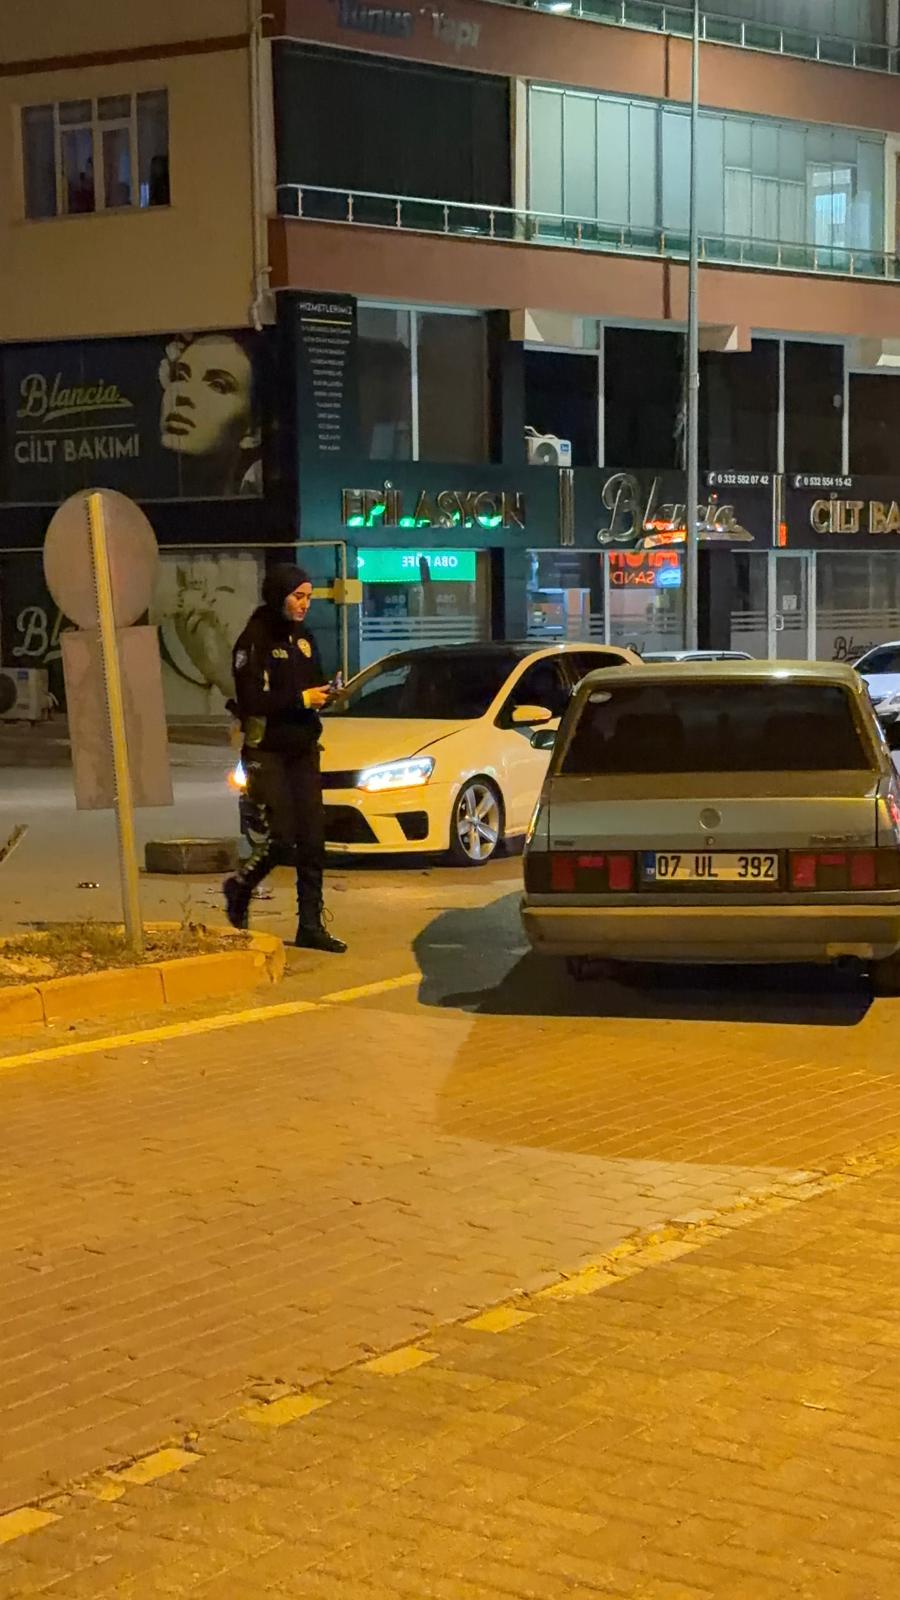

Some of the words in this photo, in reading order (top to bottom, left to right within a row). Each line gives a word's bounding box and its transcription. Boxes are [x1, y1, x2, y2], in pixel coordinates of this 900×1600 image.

[16, 372, 134, 423] Blancia
[14, 434, 57, 464] CİLT
[63, 433, 140, 461] BAKIMI
[723, 474, 736, 485] 332
[760, 475, 770, 485] 42
[843, 476, 853, 487] 42
[810, 491, 865, 534] CİLT
[657, 855, 682, 877] 07
[695, 856, 719, 878] UL
[737, 856, 775, 878] 392
